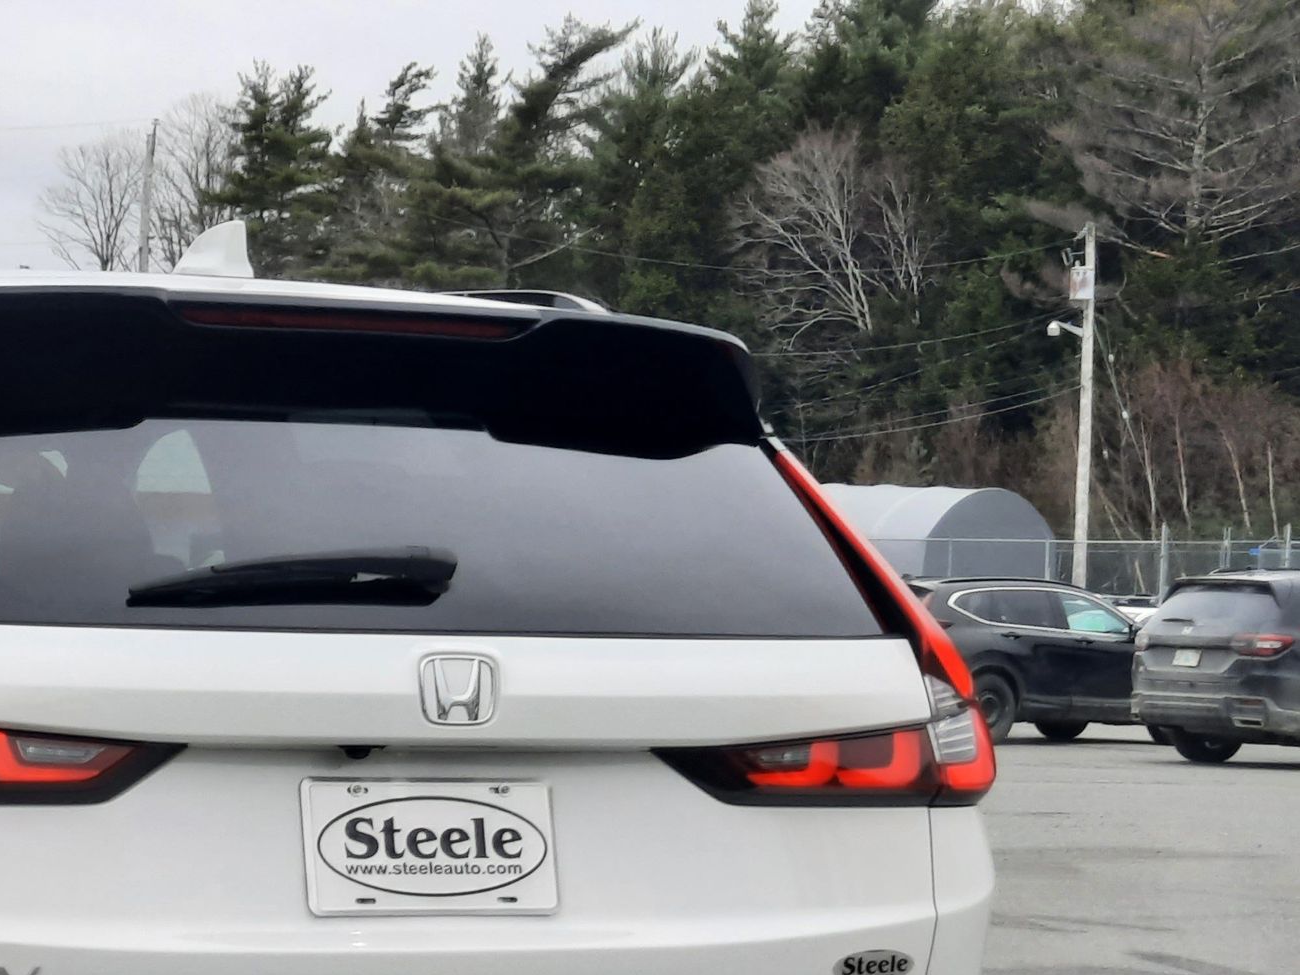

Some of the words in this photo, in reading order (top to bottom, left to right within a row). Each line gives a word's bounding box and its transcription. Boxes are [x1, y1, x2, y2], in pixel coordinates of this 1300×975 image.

[344, 816, 523, 860] Steele
[345, 862, 523, 876] www.steeleauto.com
[842, 955, 908, 975] Steele
